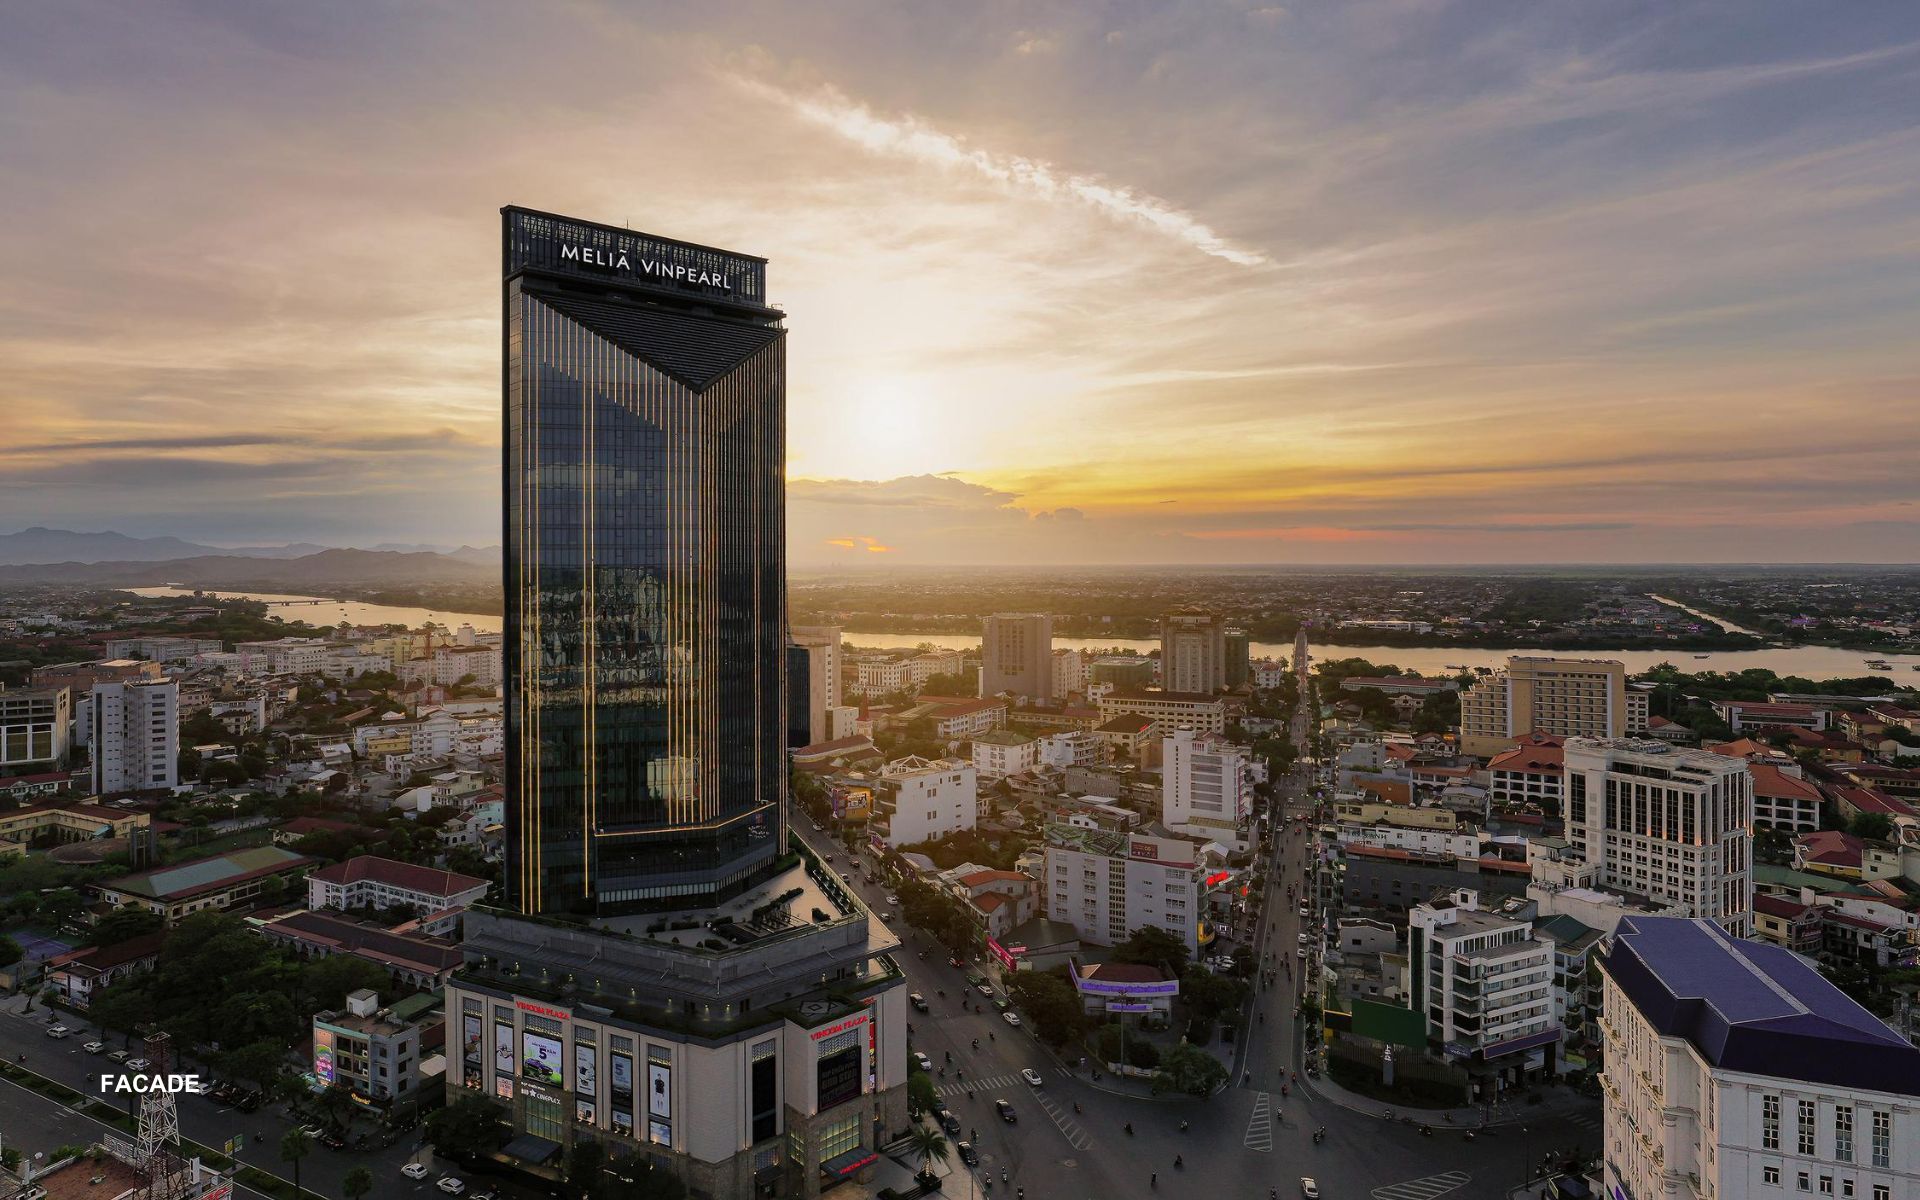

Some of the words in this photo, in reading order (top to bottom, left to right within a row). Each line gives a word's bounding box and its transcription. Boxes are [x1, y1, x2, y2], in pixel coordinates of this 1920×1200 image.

[641, 259, 731, 289] VINPEARL
[516, 1001, 545, 1014] VINCOM
[545, 1008, 571, 1020] PLAZA
[811, 1023, 843, 1041] VINCOM
[843, 1015, 868, 1030] PLAZA
[539, 1048, 547, 1060] 5
